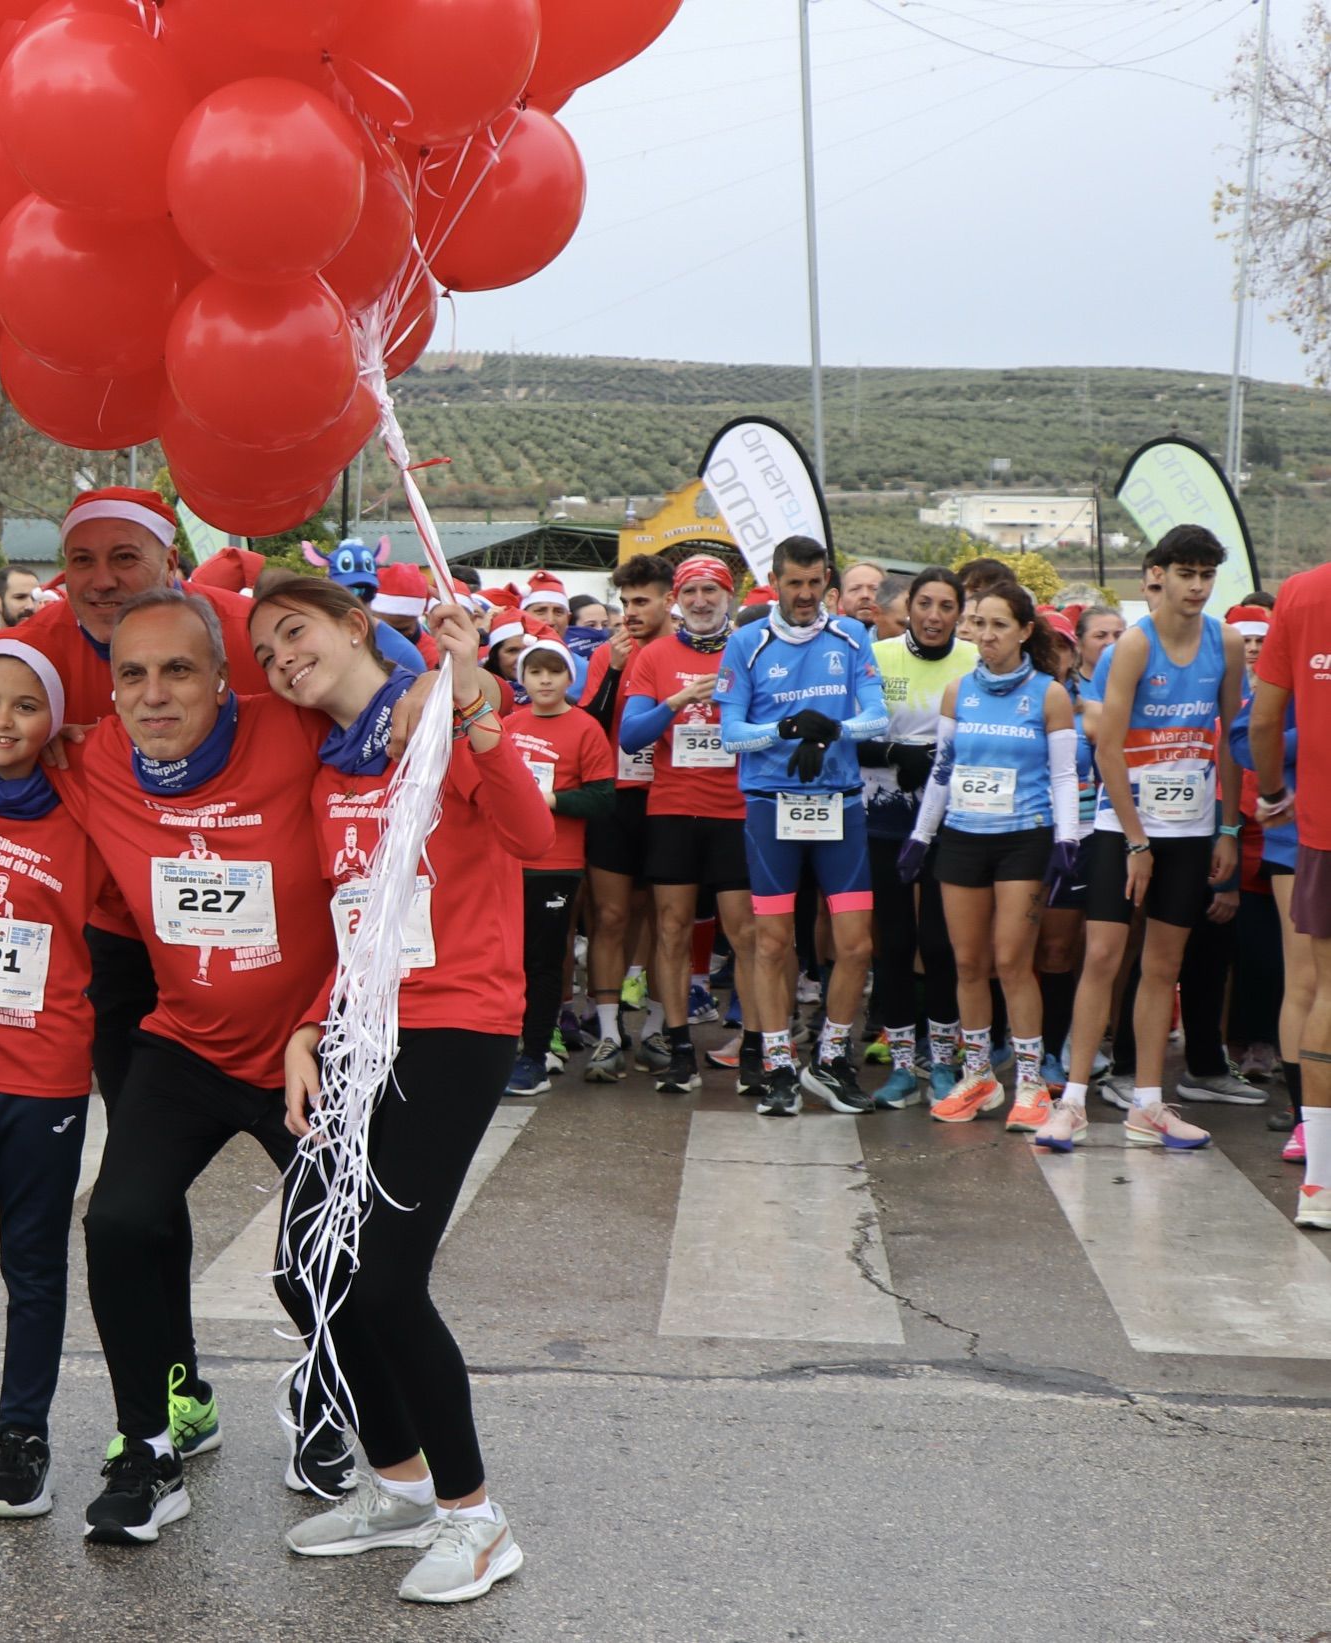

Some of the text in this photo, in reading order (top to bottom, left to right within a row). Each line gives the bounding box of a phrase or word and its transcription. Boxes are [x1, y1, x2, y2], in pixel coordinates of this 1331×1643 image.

[772, 684, 848, 704] TROTASIERRA
[686, 738, 722, 750] 349
[962, 780, 1000, 794] 624
[1155, 787, 1194, 801] 279
[330, 805, 356, 818] Ciudad
[356, 806, 369, 818] de
[790, 807, 830, 821] 625
[159, 812, 262, 828] Ciudad de Lucena
[13, 858, 29, 874] de
[29, 864, 63, 893] Lucena
[178, 888, 246, 913] 227
